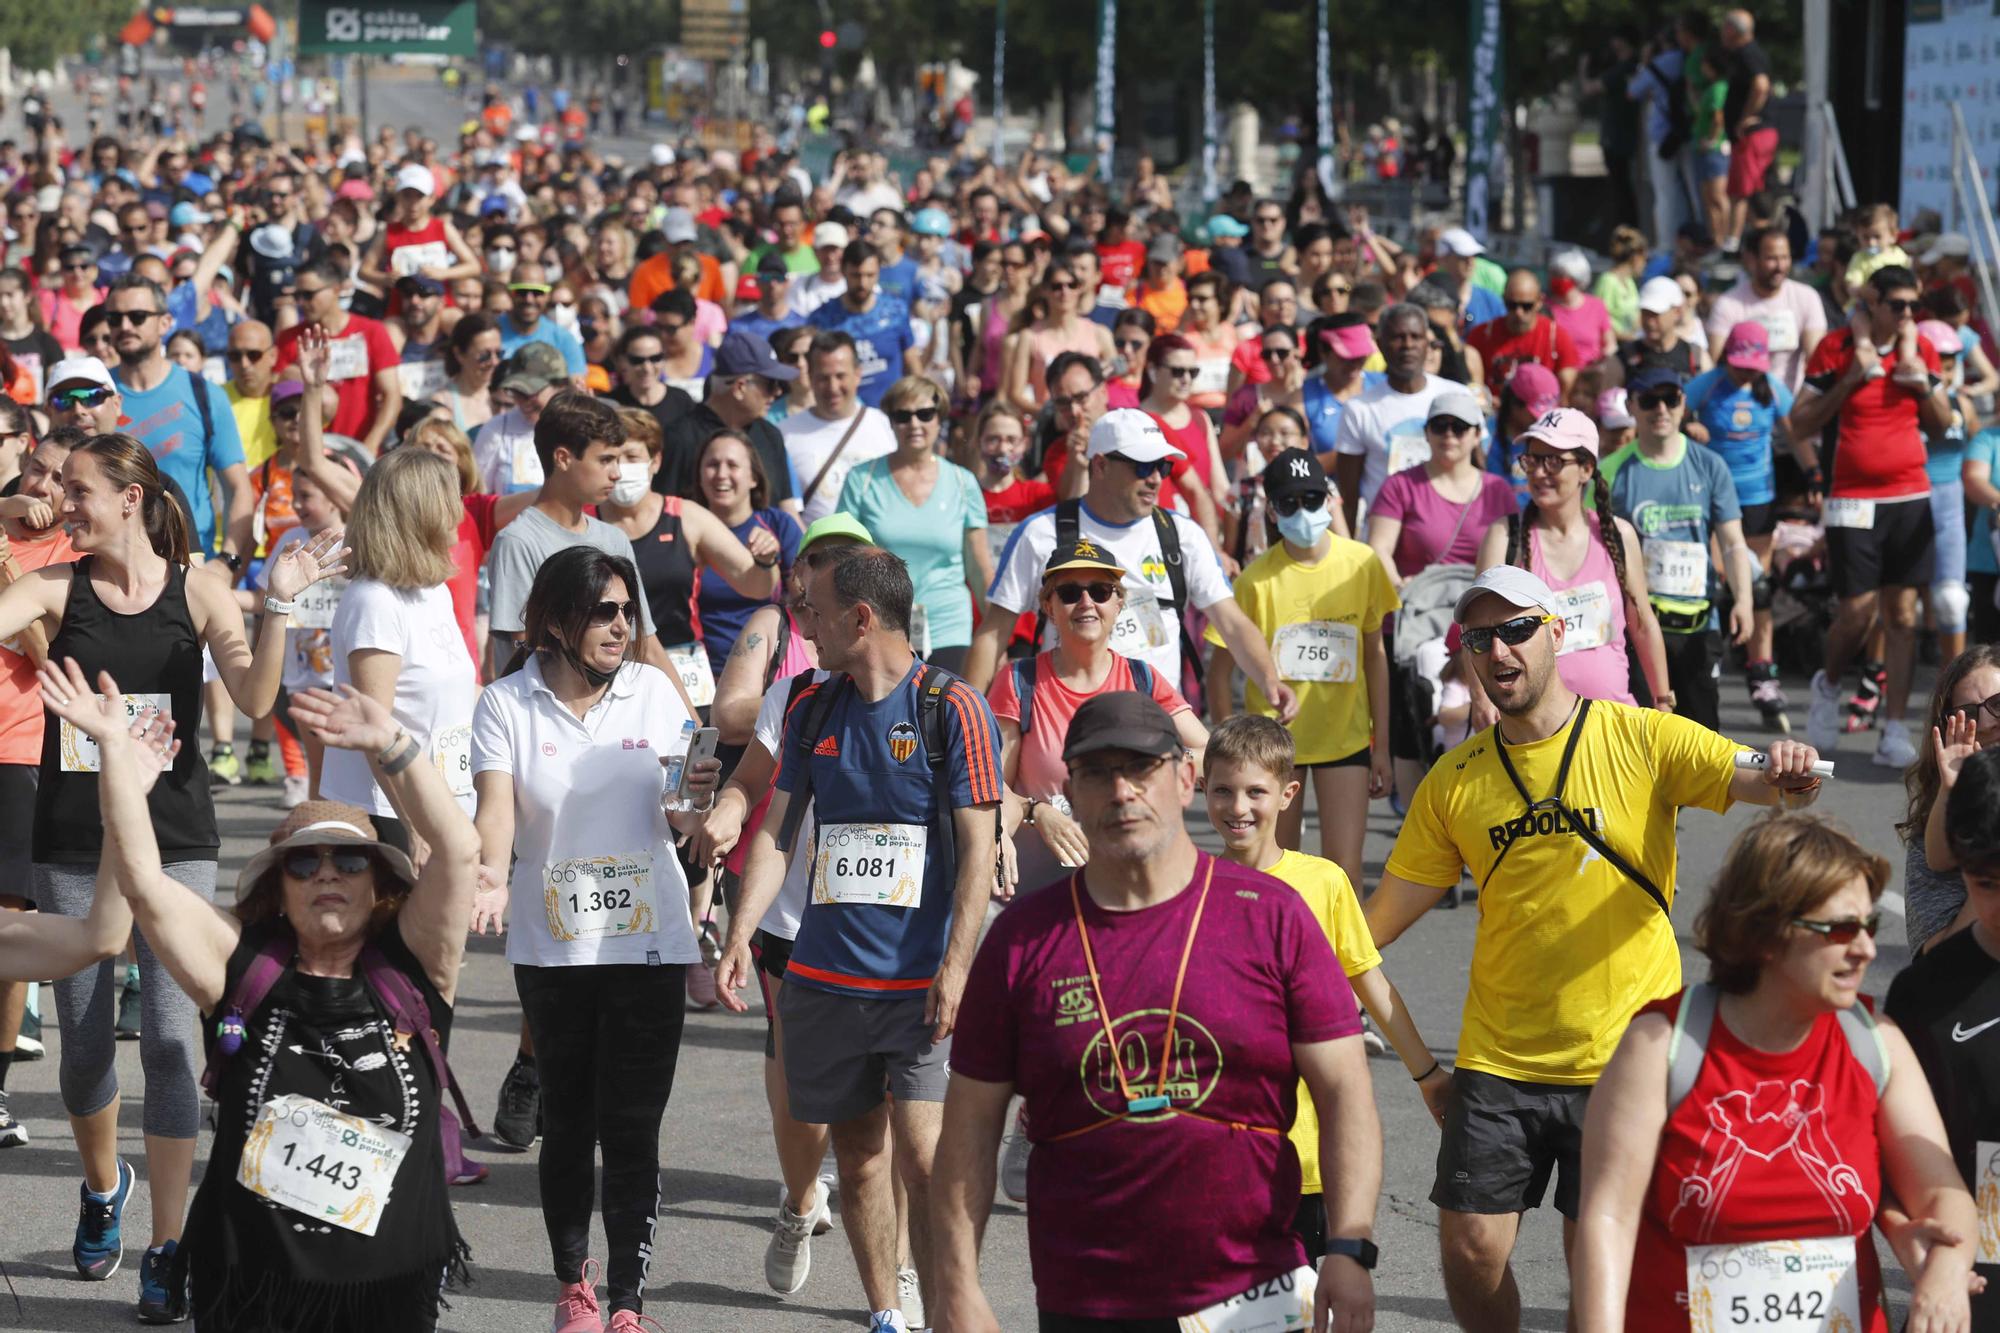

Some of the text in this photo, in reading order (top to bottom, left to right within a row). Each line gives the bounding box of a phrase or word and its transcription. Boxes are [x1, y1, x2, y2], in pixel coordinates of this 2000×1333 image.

[363, 10, 420, 24] caixa
[363, 25, 451, 42] popular
[1110, 619, 1137, 640] 55
[1297, 645, 1329, 661] 756
[814, 747, 840, 757] adidas
[460, 754, 471, 771] 8
[826, 827, 850, 848] 66
[551, 863, 576, 883] 66
[617, 868, 649, 877] popular
[836, 857, 895, 878] 6.081
[569, 888, 631, 913] 1.362
[283, 1142, 362, 1190] 1.443
[1701, 1250, 1742, 1280] 66
[1731, 1290, 1826, 1326] 5.842
